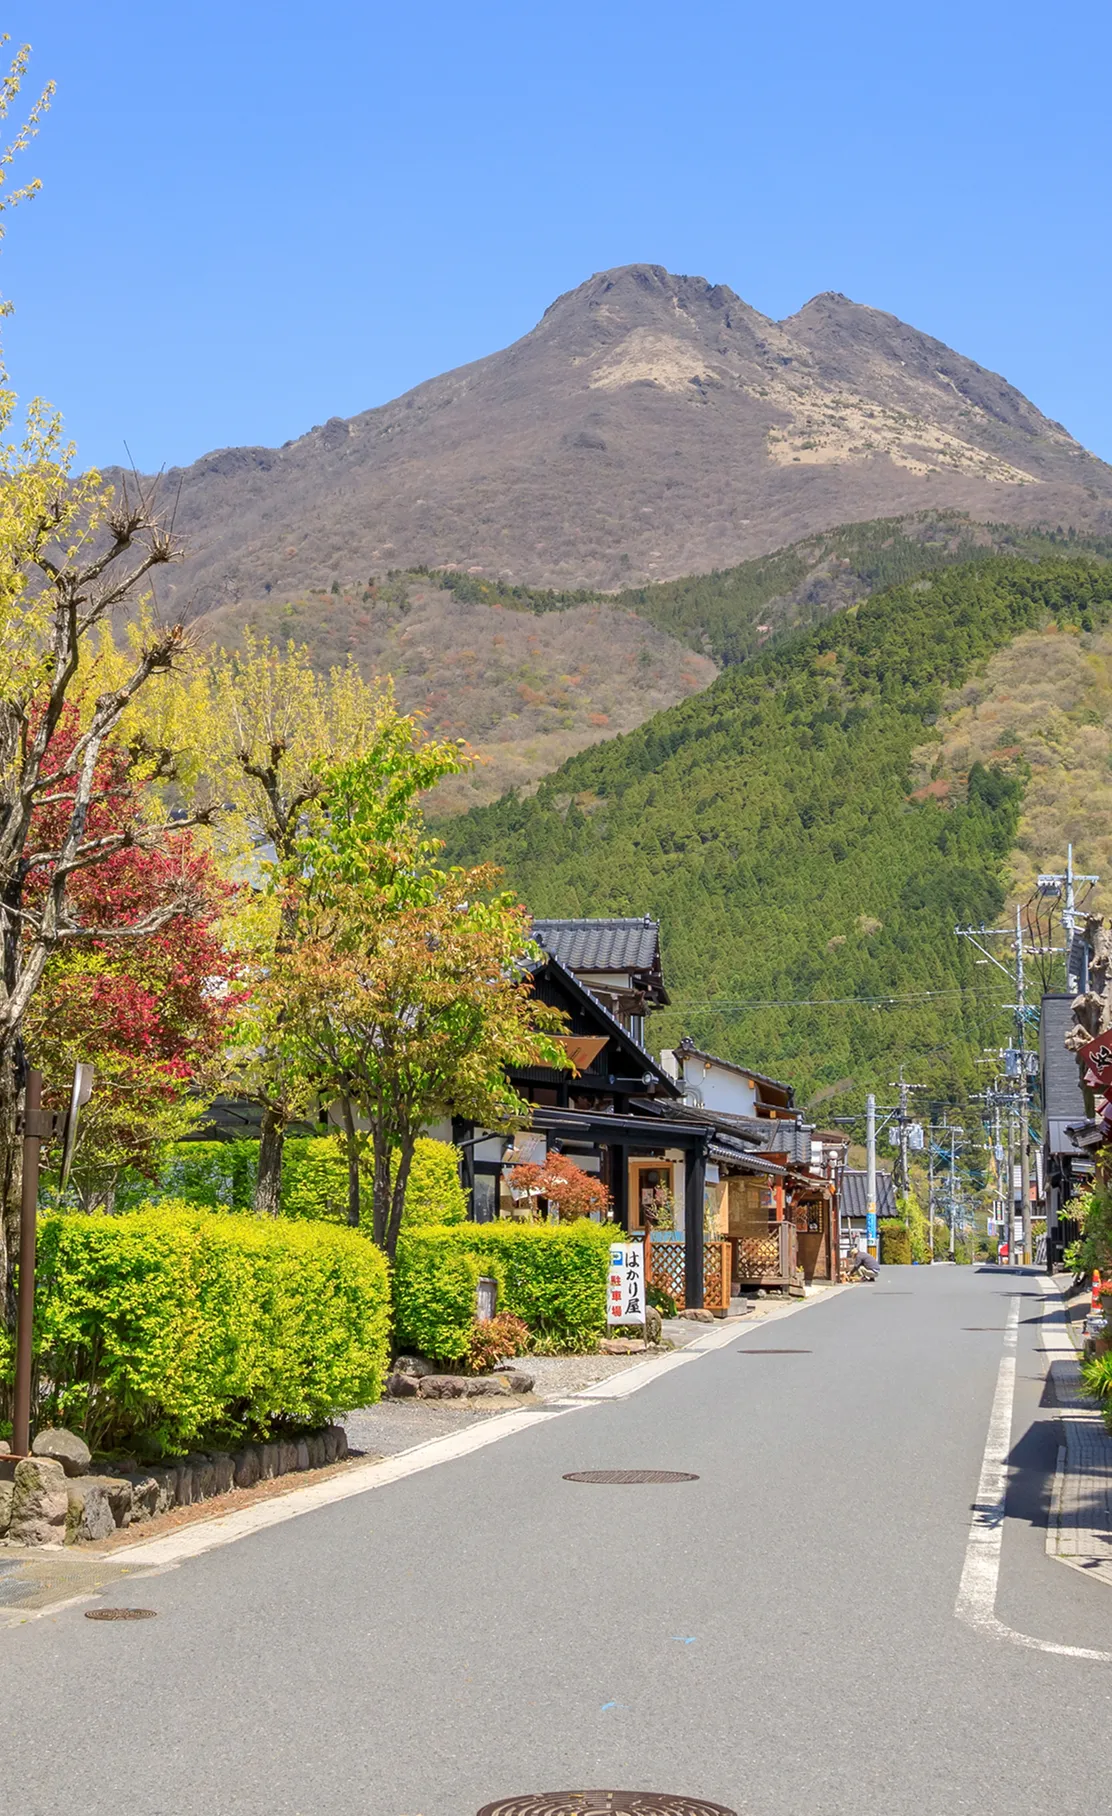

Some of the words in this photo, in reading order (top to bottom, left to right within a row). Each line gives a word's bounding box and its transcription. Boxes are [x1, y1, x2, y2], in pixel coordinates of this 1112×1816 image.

[611, 1275, 623, 1317] 駐車場
[625, 1251, 641, 1314] はかり屋
